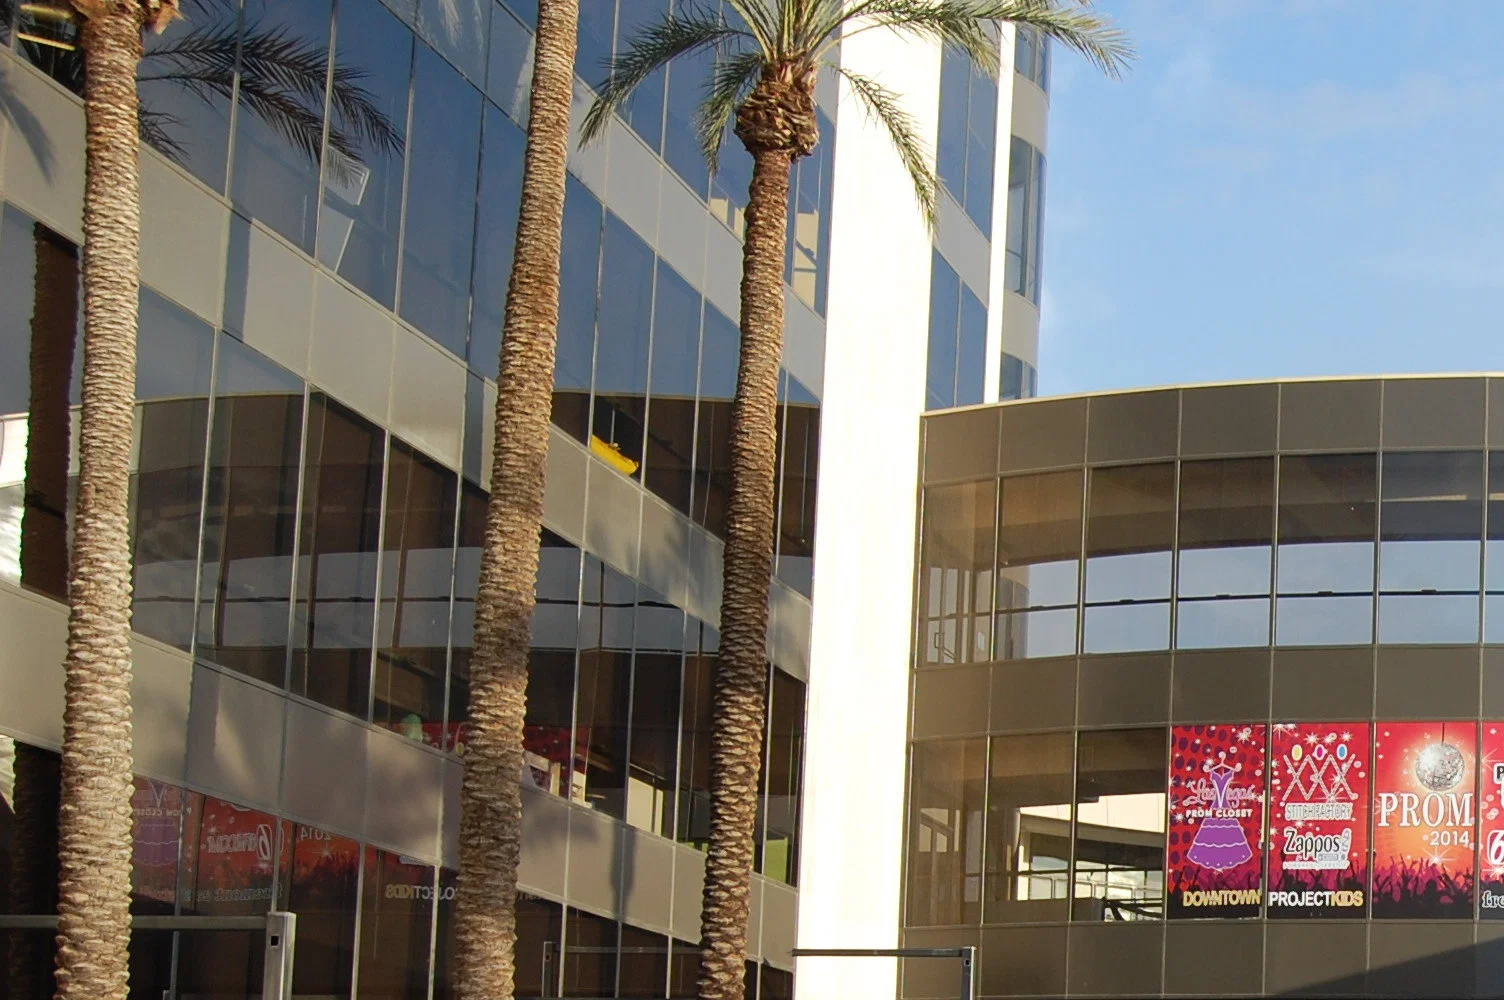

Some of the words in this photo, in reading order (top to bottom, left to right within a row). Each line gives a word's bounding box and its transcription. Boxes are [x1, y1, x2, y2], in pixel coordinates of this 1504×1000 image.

[1185, 809, 1213, 818] PROM
[1215, 809, 1253, 818] CLOSET
[1377, 792, 1474, 827] PROM
[1284, 829, 1340, 858] Zappos
[1429, 830, 1470, 847] 2014
[1182, 890, 1262, 907] DOWNTOWN
